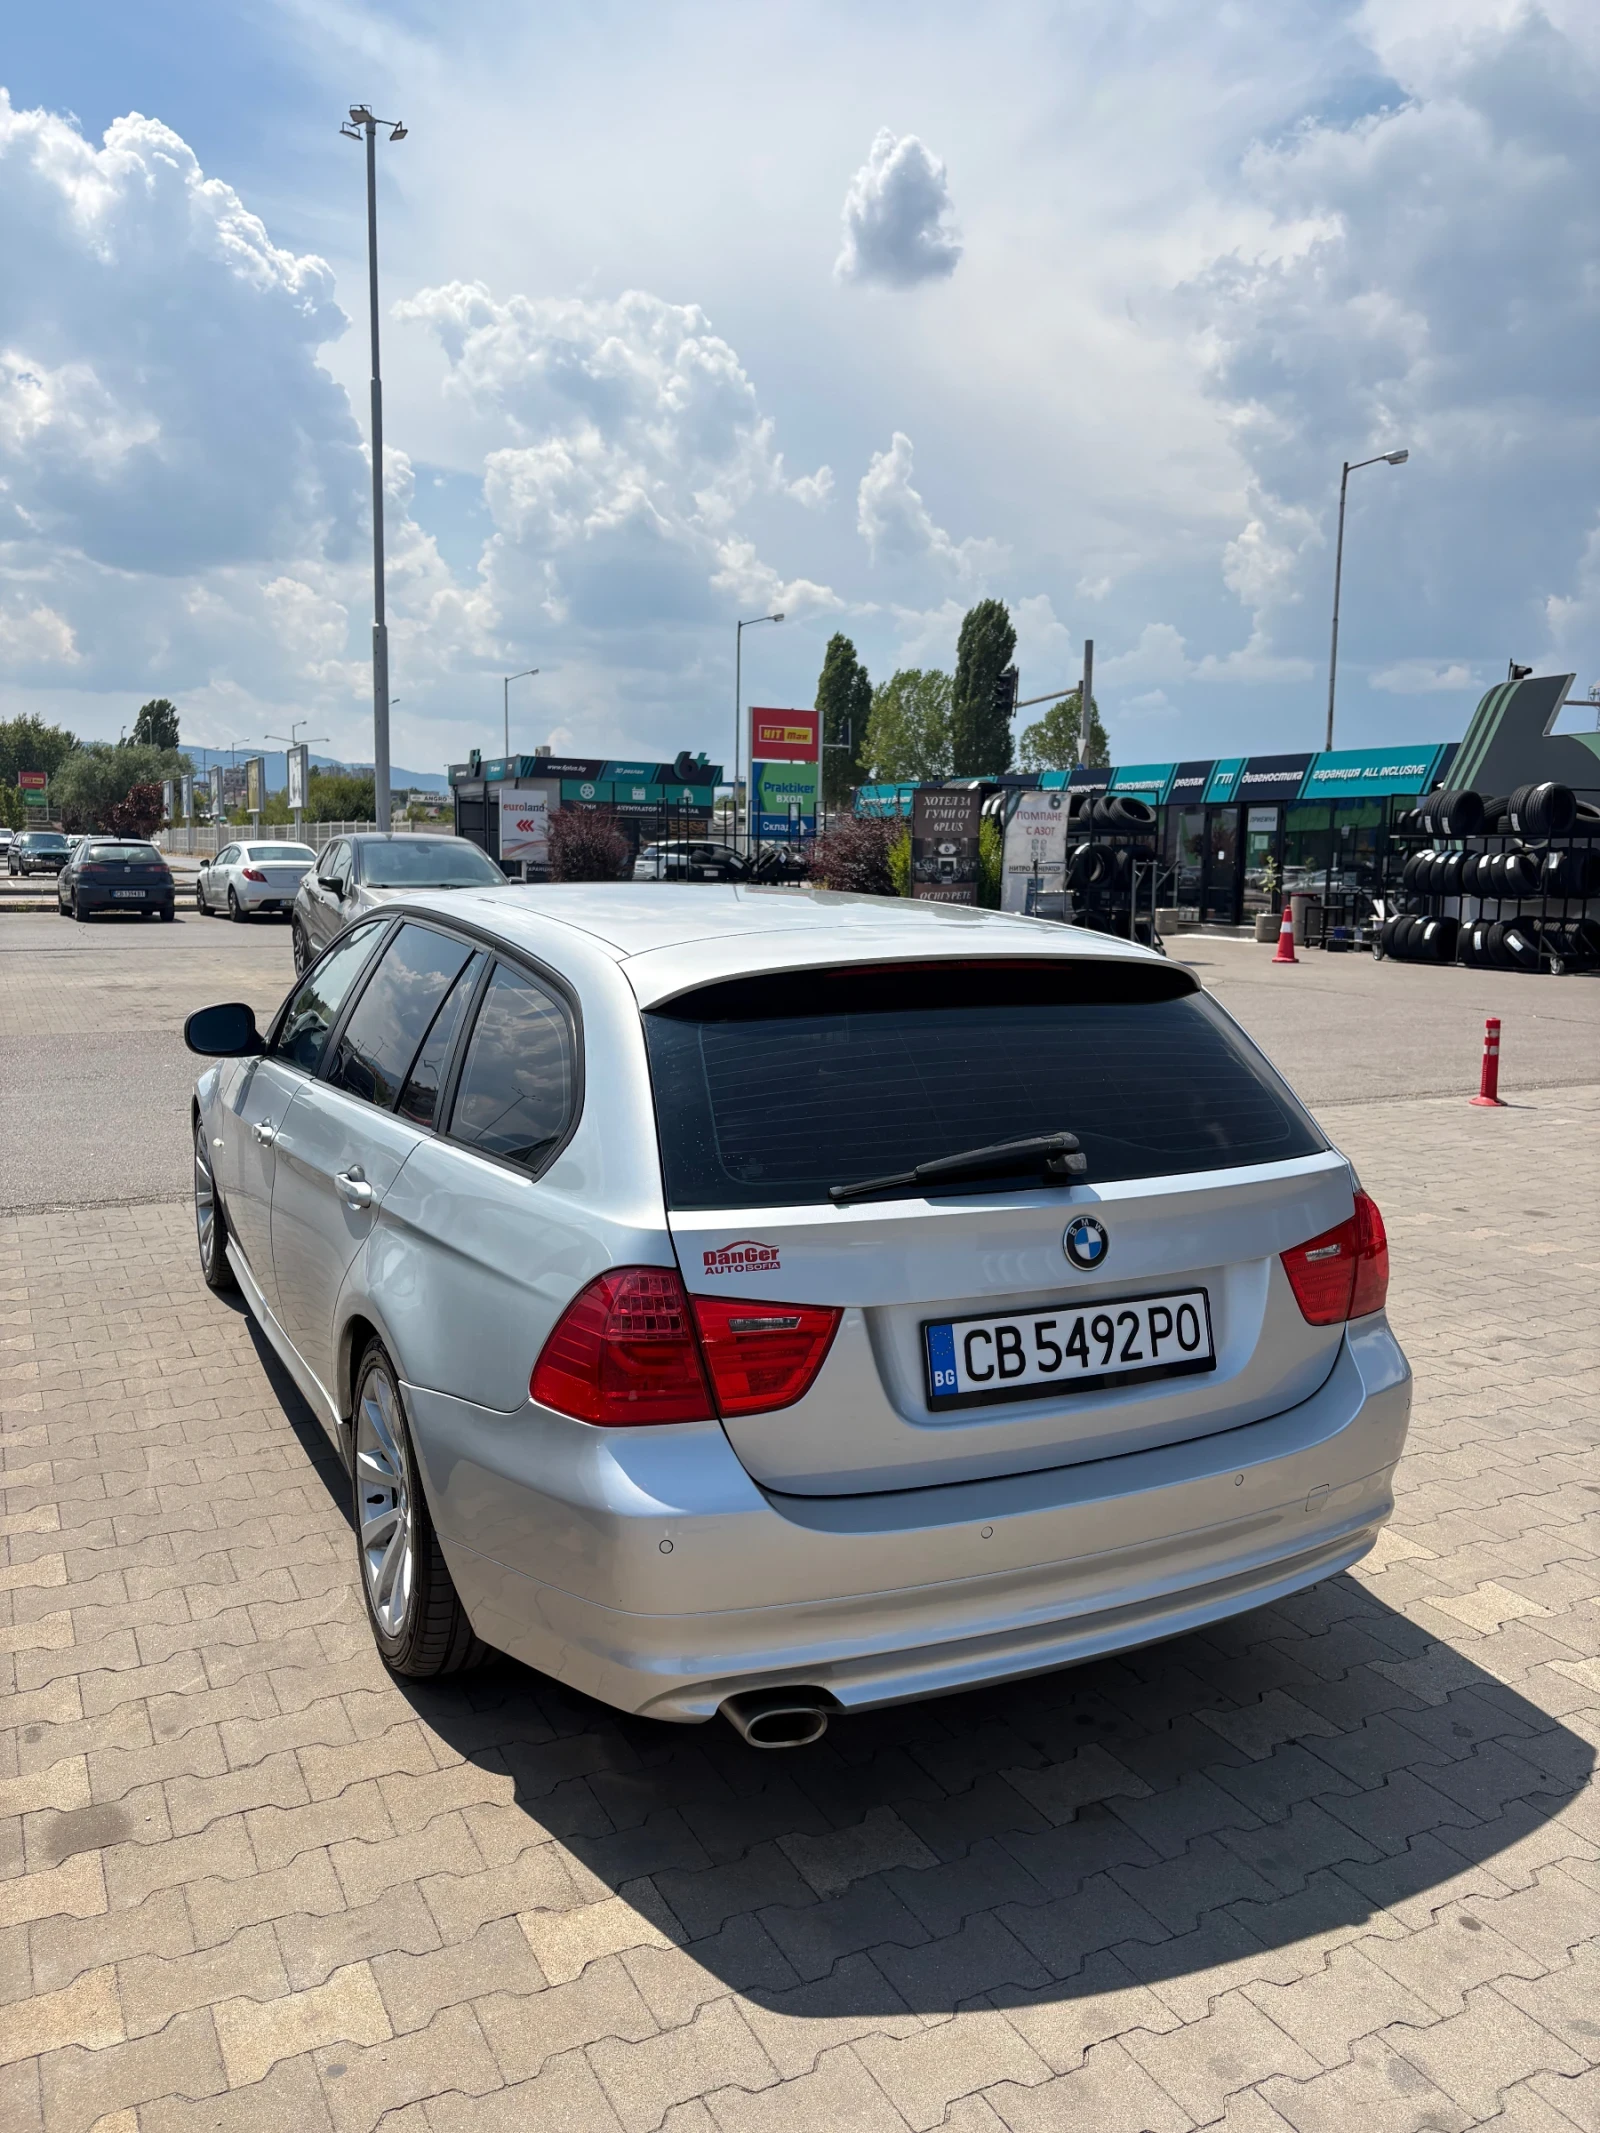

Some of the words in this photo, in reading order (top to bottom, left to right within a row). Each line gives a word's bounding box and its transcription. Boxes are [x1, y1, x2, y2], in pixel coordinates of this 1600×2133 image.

[763, 729, 782, 740] HIT
[547, 764, 587, 773] www.6plus.bg
[1313, 768, 1362, 782] гаранция
[1363, 767, 1378, 778] ALL
[1381, 764, 1427, 776] INCLUSIVE
[1173, 776, 1205, 789] реглаж
[1242, 770, 1304, 784] диагностика
[764, 782, 815, 794] Praktiker
[503, 802, 545, 812] euroland
[923, 796, 958, 806] ХОТЕЛ
[959, 796, 971, 806] ЗА
[925, 809, 956, 819] ГУМИ
[957, 809, 971, 819] ОТ
[1016, 810, 1062, 822] ПОМПАНЕ
[933, 822, 963, 832] 6PLUS
[1033, 826, 1055, 836] АЗОТ
[703, 1247, 779, 1266] DanGer
[704, 1264, 745, 1275] AUTO
[746, 1262, 780, 1271] SOFIA
[934, 1369, 955, 1387] BG
